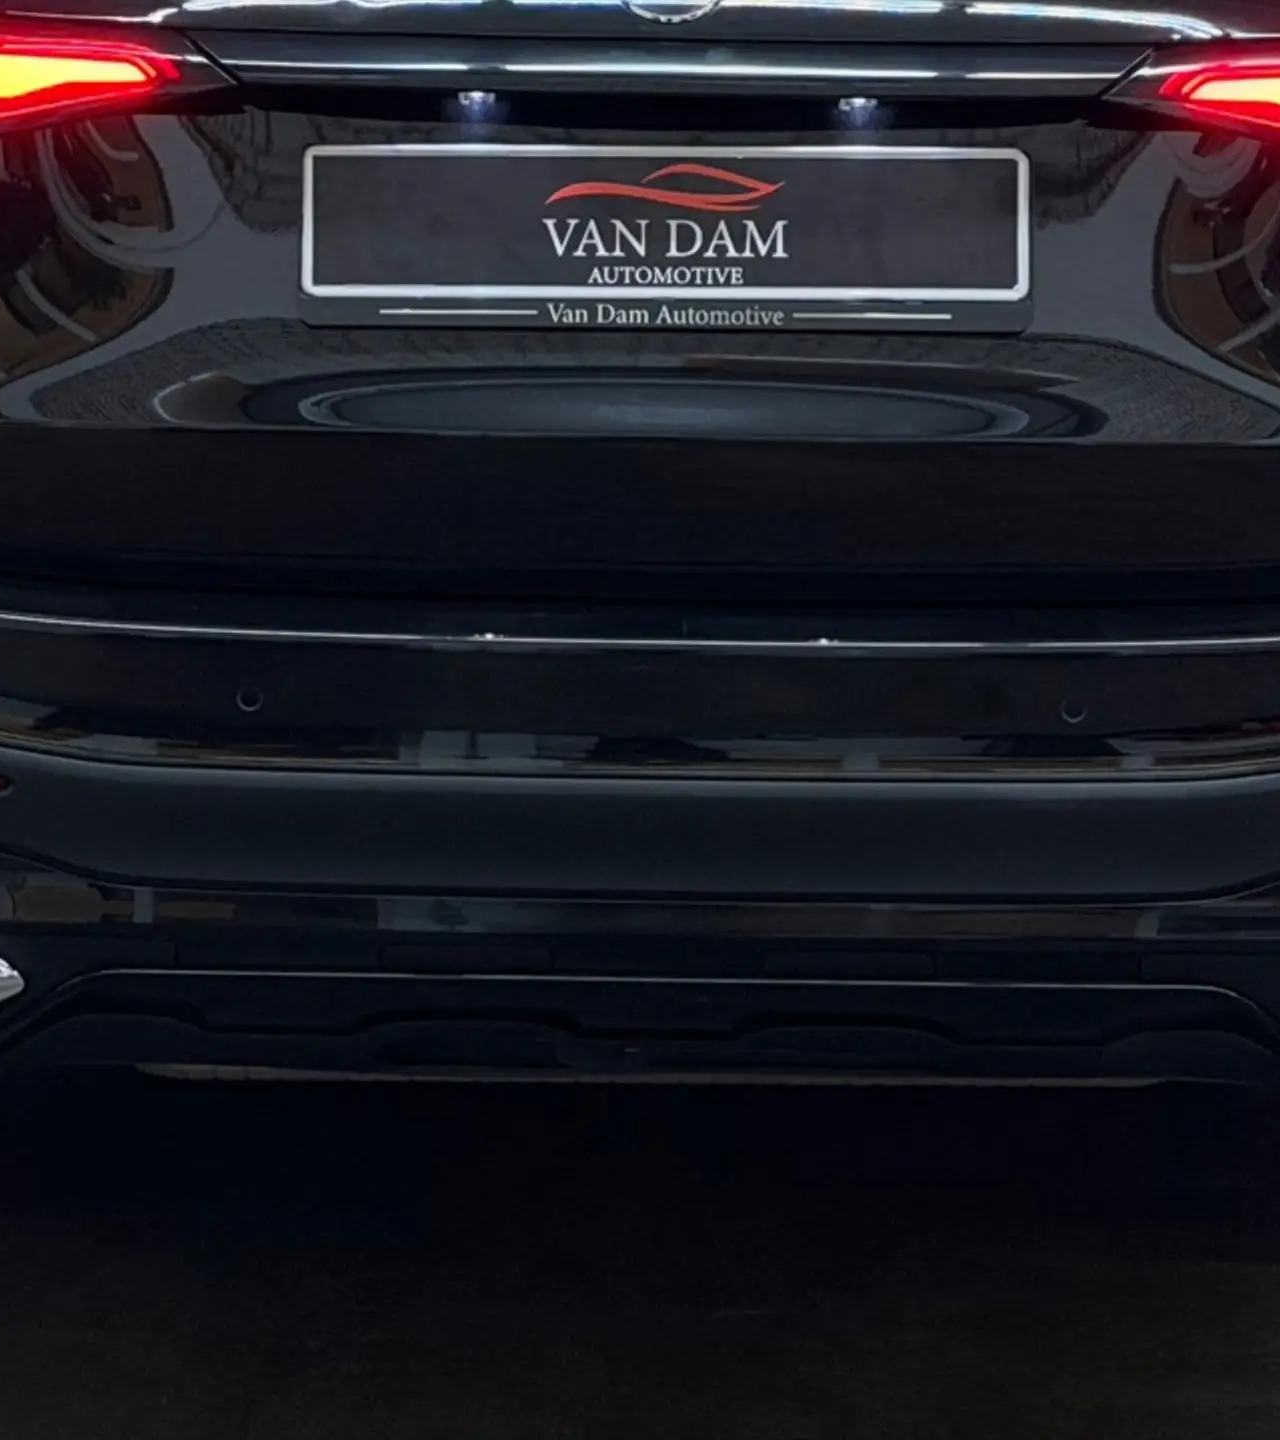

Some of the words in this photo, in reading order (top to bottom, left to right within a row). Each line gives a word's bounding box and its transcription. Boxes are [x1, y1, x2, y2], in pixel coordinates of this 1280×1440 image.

[542, 218, 649, 258] VAN
[665, 219, 789, 259] DAM
[587, 266, 744, 286] AUTOMOTIVE
[547, 302, 588, 325] Van
[596, 303, 651, 326] Dam
[655, 302, 785, 328] Automotive
